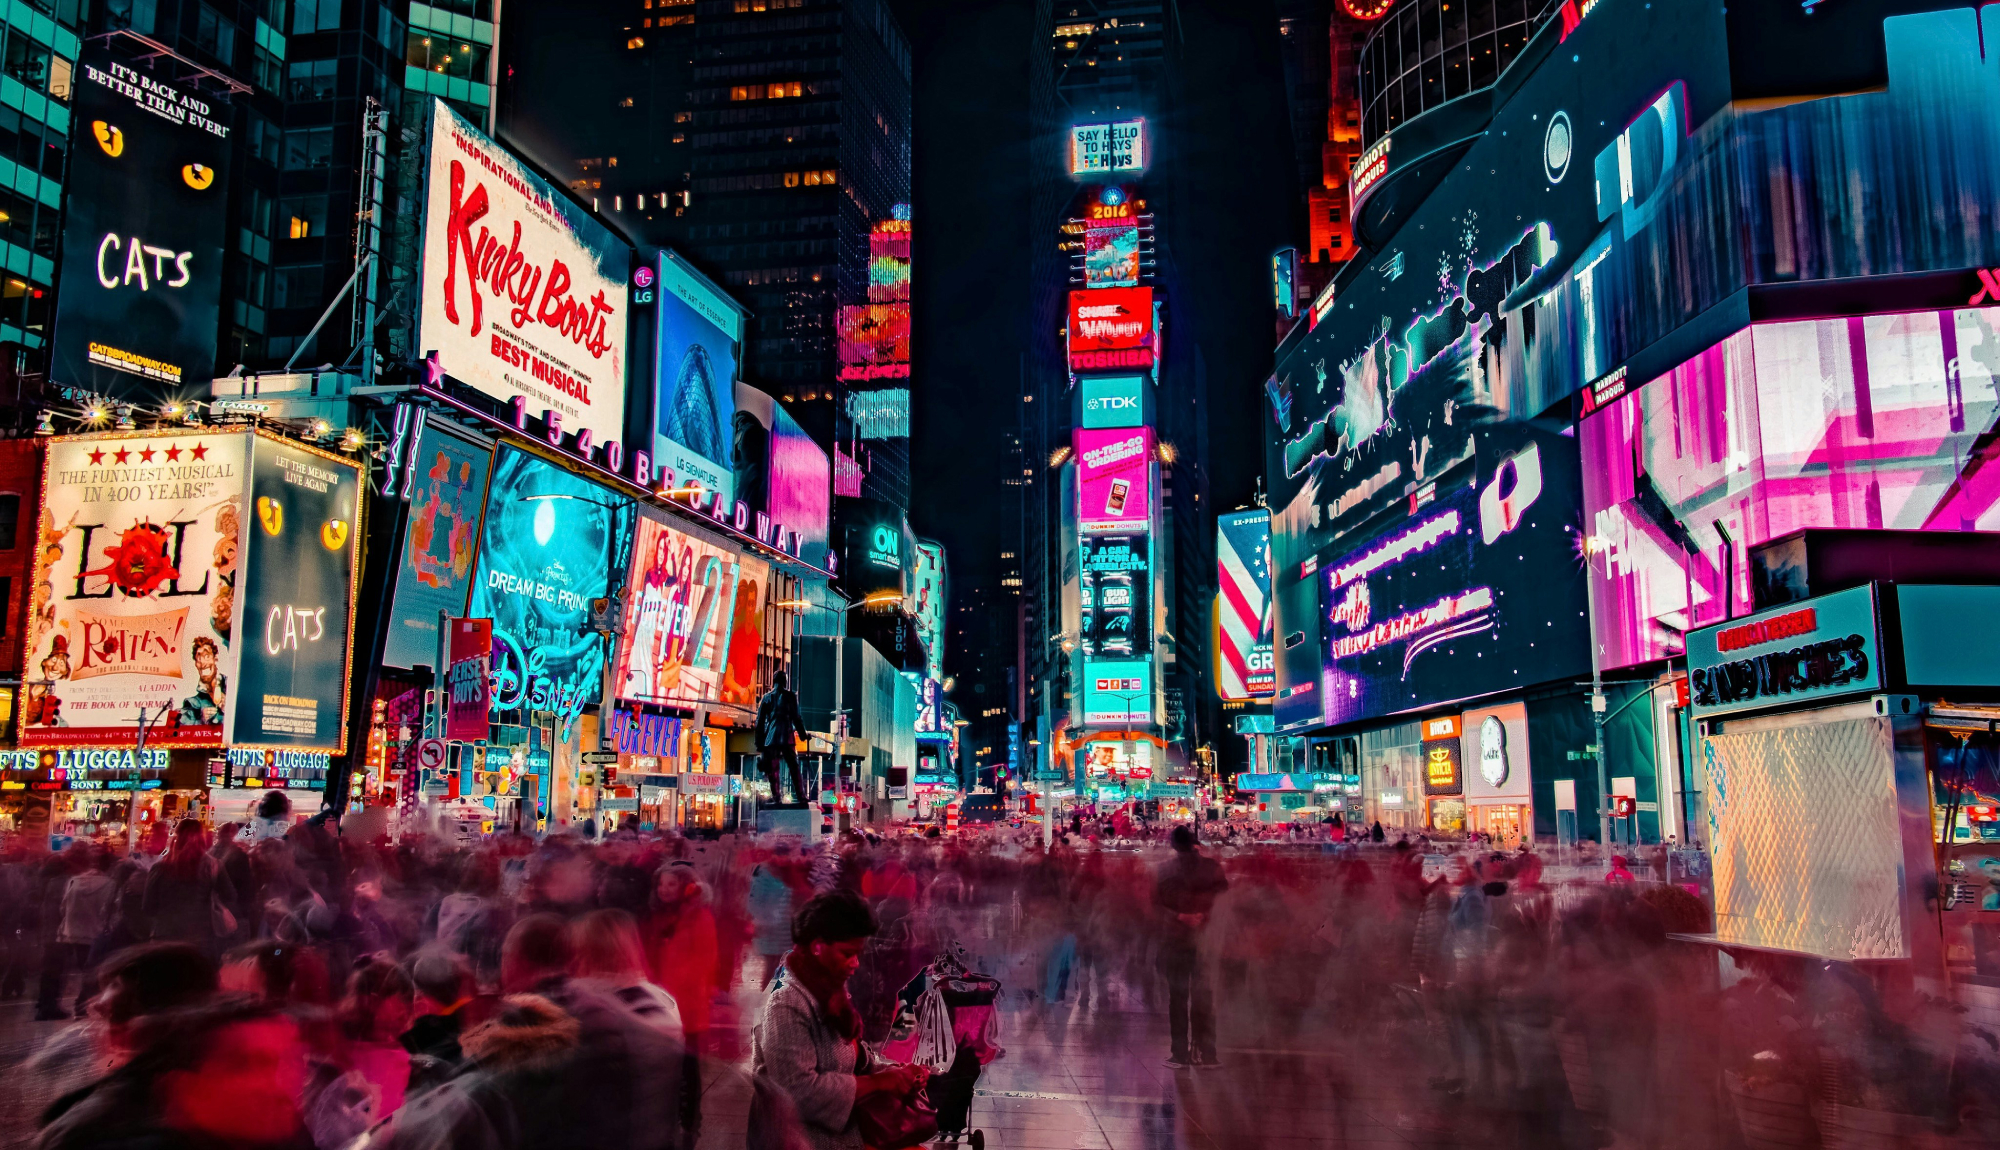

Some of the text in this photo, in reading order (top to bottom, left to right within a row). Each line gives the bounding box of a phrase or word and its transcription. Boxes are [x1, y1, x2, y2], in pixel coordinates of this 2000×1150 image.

[110, 62, 210, 116] IT'S BACK AND
[146, 92, 187, 120] THAN
[1078, 127, 1138, 142] SAY HELLO
[1084, 139, 1131, 152] TO HAYS
[1101, 154, 1132, 167] Hays
[1354, 138, 1391, 182] MARRIOTT
[1355, 160, 1386, 198] MARQUIS
[534, 194, 552, 215] AND
[1094, 205, 1127, 219] 2016
[1085, 216, 1138, 228] TOSHIBA
[97, 233, 193, 291] CATS
[444, 160, 615, 359] Kinky Boots
[634, 291, 653, 303] LG
[677, 284, 726, 328] THE ART OF ESSENCE
[492, 322, 525, 346] BROADWAY'S
[539, 349, 549, 359] AND
[89, 342, 181, 376] CATSBROADWAY.COM
[491, 333, 591, 406] BEST MUSICAL
[1072, 349, 1152, 369] TOSHIBA
[1594, 365, 1628, 393] MARRIOTT
[1099, 396, 1137, 409] TDK
[1595, 381, 1625, 405] MARQUIS
[221, 401, 264, 411] LAMAR
[1083, 436, 1143, 461] ON-THE-GO
[1087, 444, 1143, 469] ORDERING
[59, 464, 234, 484] THE FUNNIEST MUSICAL
[275, 455, 339, 485] LET THE MEMORY
[511, 394, 804, 558] 1540 BROADWAY
[676, 456, 718, 487] LG SIGNATURE
[285, 471, 328, 493] LIVE AGAIN
[83, 486, 103, 503] IN
[107, 486, 141, 502] 400
[1233, 516, 1269, 526] EX-PRESID
[875, 527, 898, 555] ON
[1099, 546, 1130, 555] A CAN
[1084, 562, 1119, 572] QUEEN
[1091, 553, 1139, 563] FIT FOR A
[489, 570, 556, 606] DREAM BIG,
[1103, 596, 1130, 605] LIGHT
[631, 556, 740, 673] FOREVER 21
[266, 604, 324, 655] CATS
[1717, 607, 1817, 653] DELICATESSEN
[138, 684, 177, 692] ALADDIN
[453, 678, 482, 703] BOYS
[70, 701, 130, 710] THE BOOK OF
[611, 709, 681, 757] FOREVER
[56, 749, 170, 770] LUGGAGE
[227, 749, 331, 769] GIFTS LUGGAGE
[65, 769, 85, 780] NY
[278, 768, 291, 777] NY
[697, 775, 711, 785] POLO
[70, 781, 103, 790] SONY
[288, 780, 309, 788] SONY
